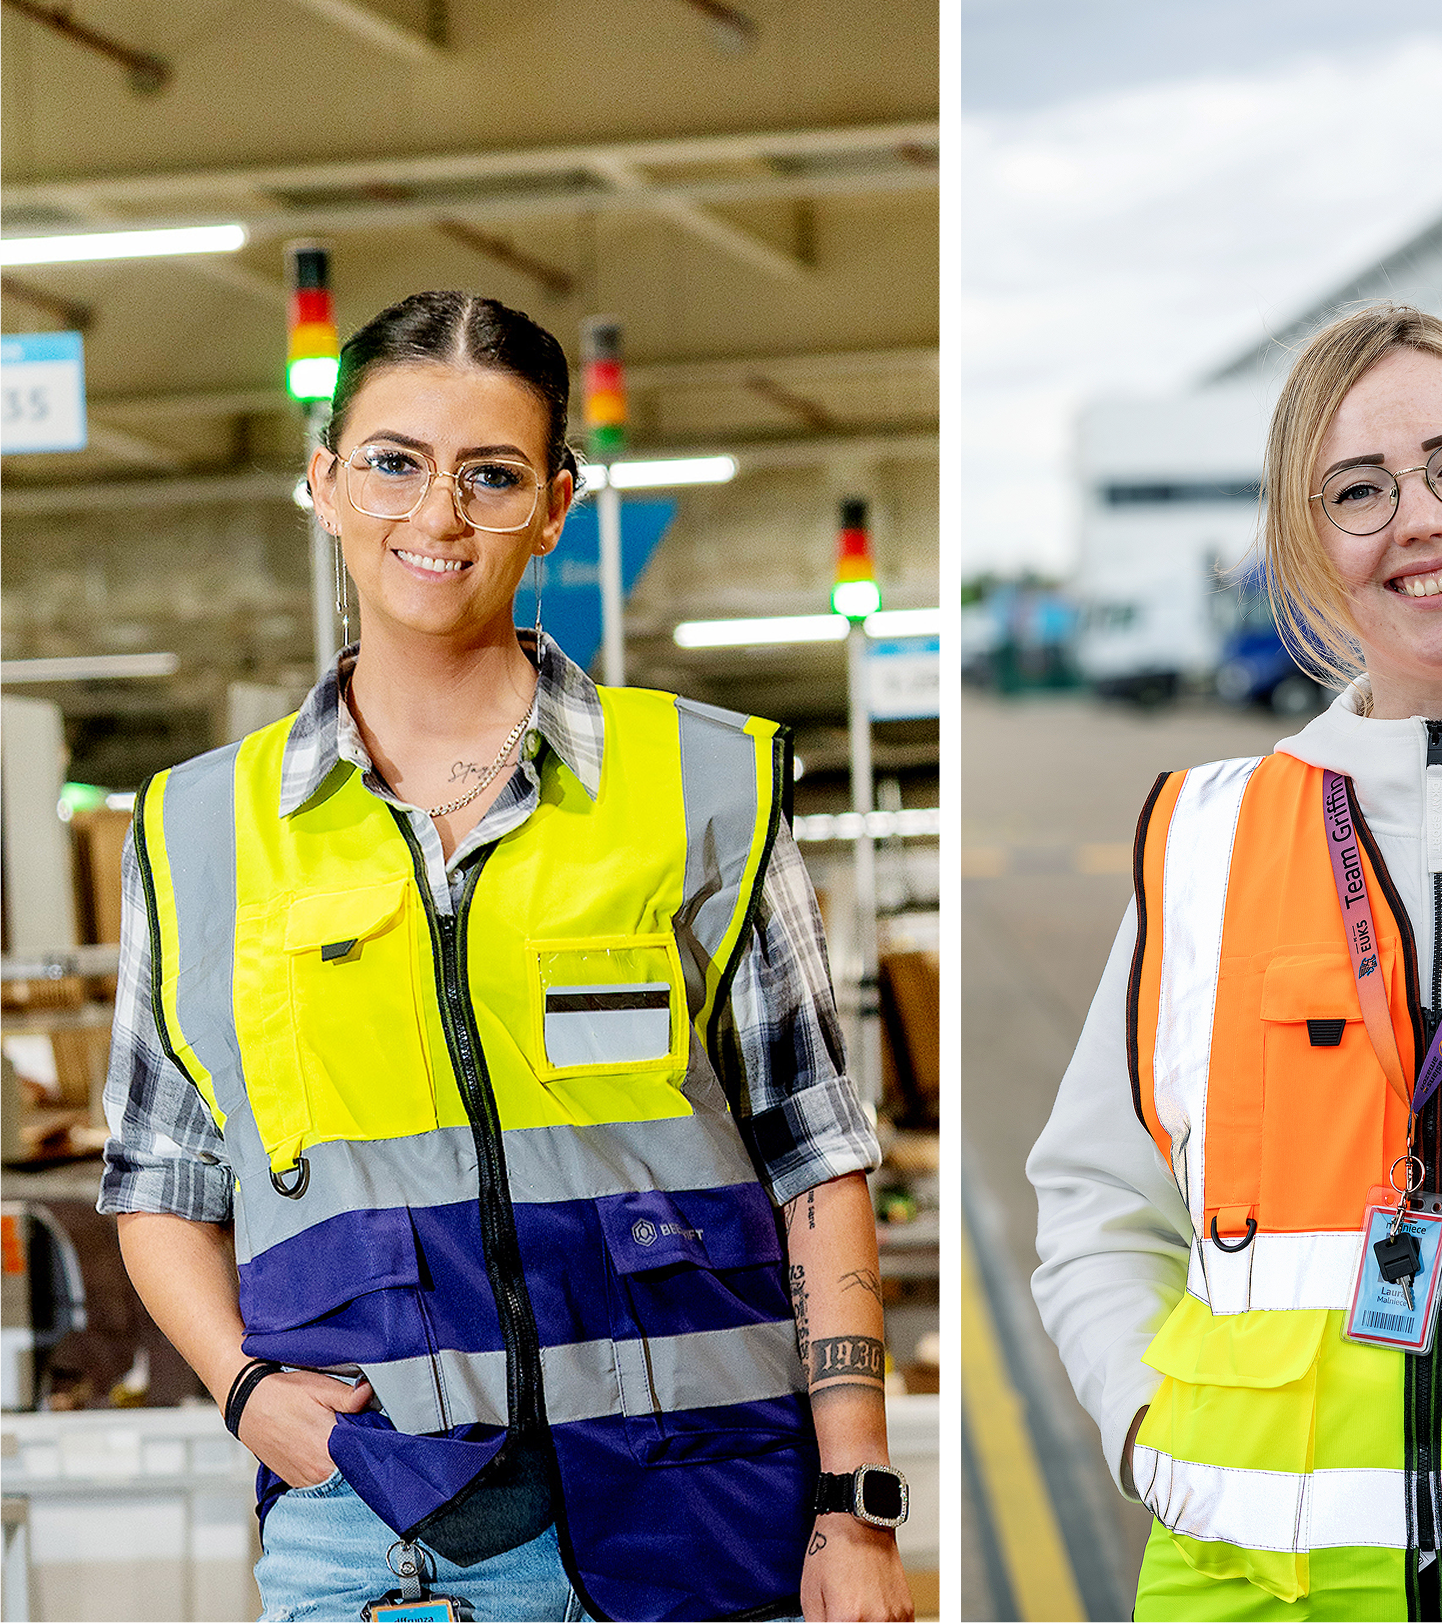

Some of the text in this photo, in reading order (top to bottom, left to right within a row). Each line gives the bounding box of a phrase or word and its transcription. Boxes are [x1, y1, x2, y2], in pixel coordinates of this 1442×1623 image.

[1326, 775, 1365, 910] Team Griffin
[1356, 919, 1372, 953] EUK5
[1420, 1056, 1439, 1090] amazon
[1386, 1222, 1427, 1235] mniece
